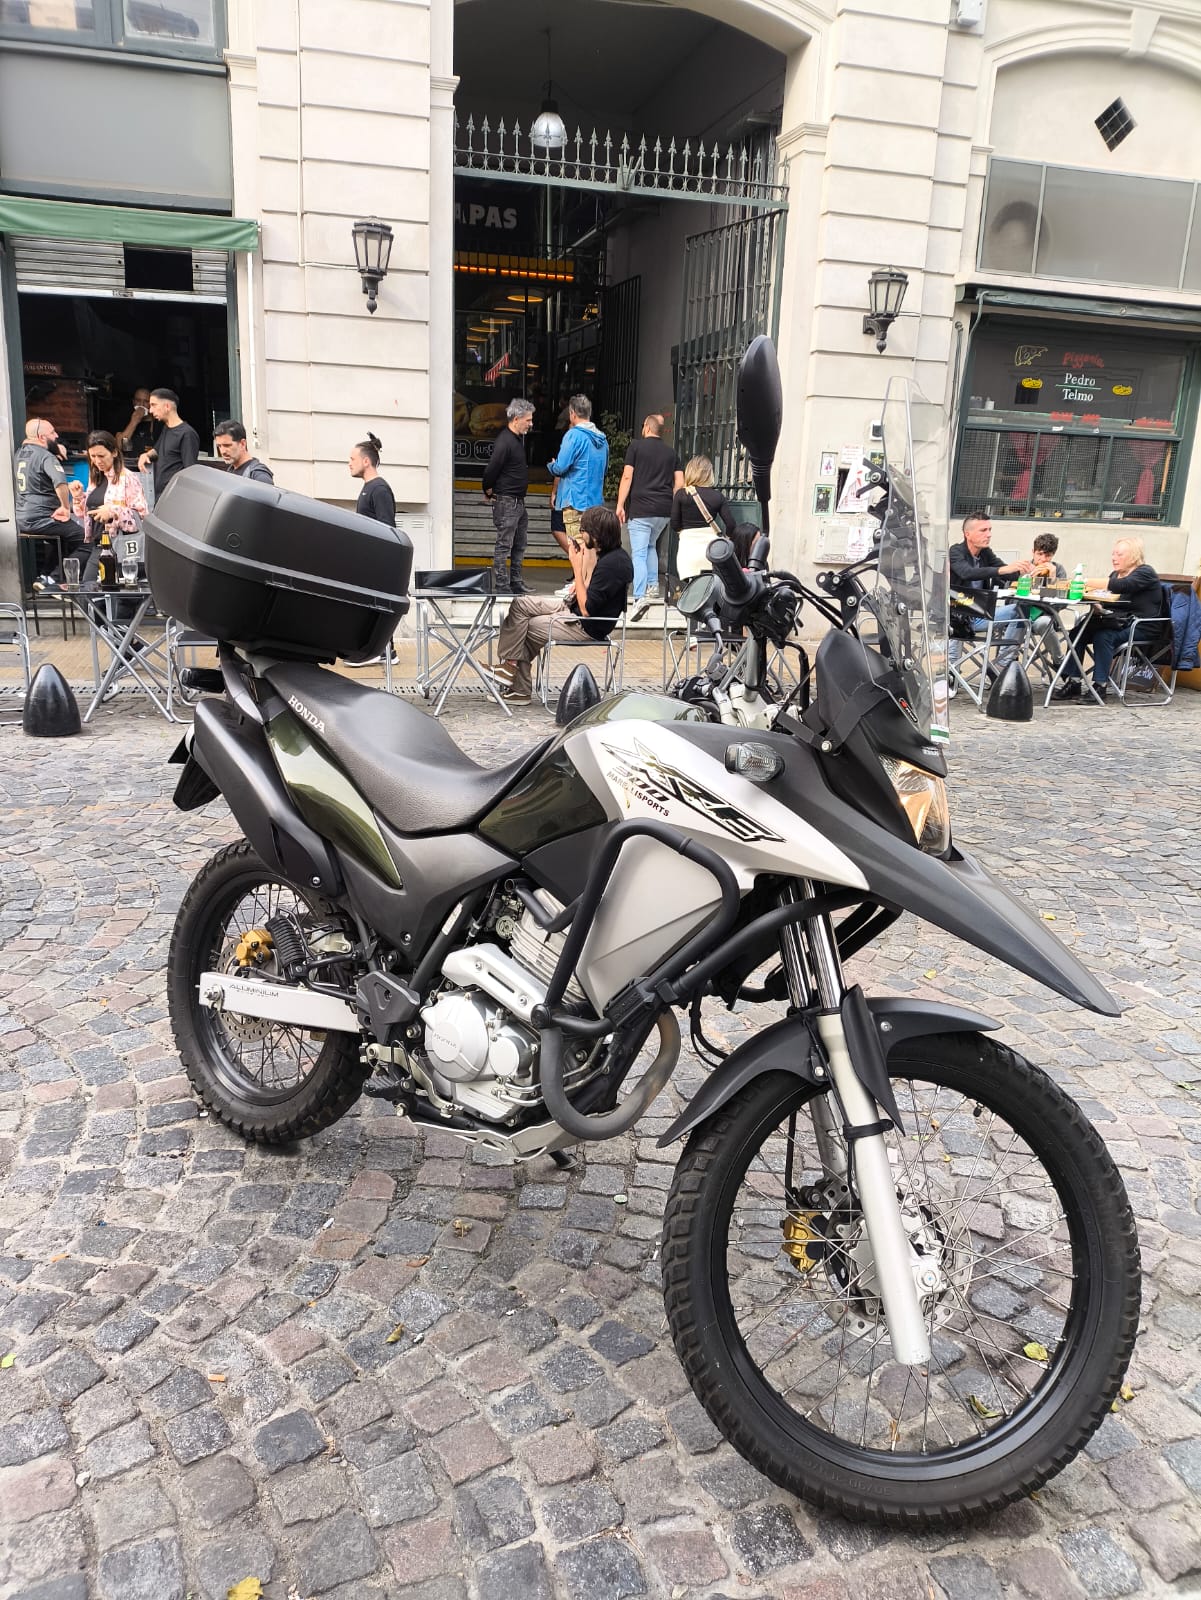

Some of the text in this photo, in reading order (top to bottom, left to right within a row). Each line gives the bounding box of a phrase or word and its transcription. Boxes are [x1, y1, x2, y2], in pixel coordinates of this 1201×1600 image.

[1064, 372, 1096, 386] Pedro
[1062, 388, 1094, 402] Telmo
[17, 461, 27, 492] 5
[126, 540, 139, 556] B
[288, 694, 325, 734] HONDA
